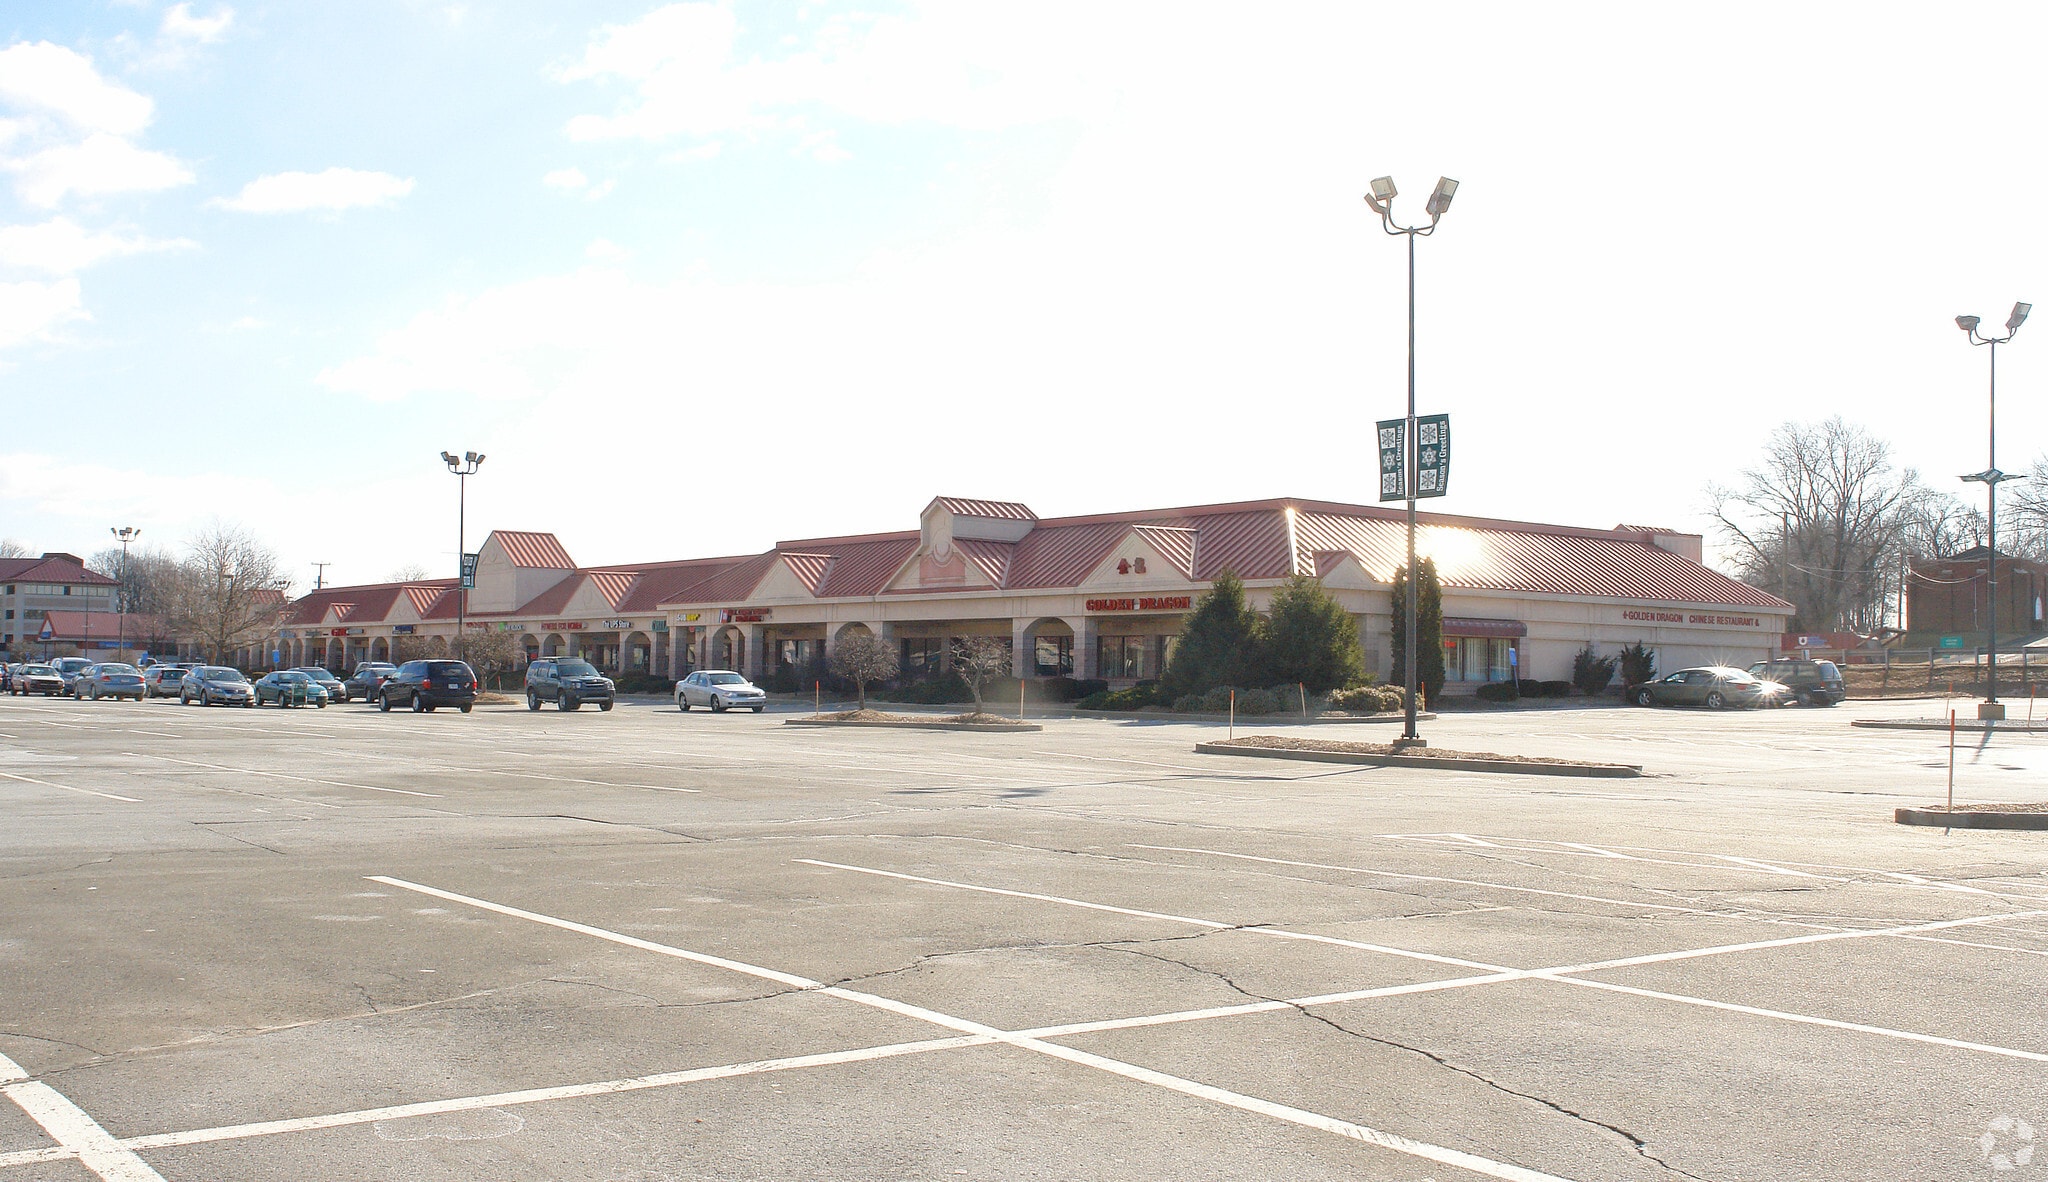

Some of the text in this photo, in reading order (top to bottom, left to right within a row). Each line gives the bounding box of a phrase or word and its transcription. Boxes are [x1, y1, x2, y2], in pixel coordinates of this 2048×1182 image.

[1438, 421, 1448, 458] Greetings
[1086, 596, 1191, 611] GOLDEN DRAGON
[1628, 611, 1655, 622] GOLDEN
[1656, 612, 1683, 623] DRAGON
[1689, 614, 1715, 625] CHINESE
[1716, 616, 1754, 626] RESTAURANT
